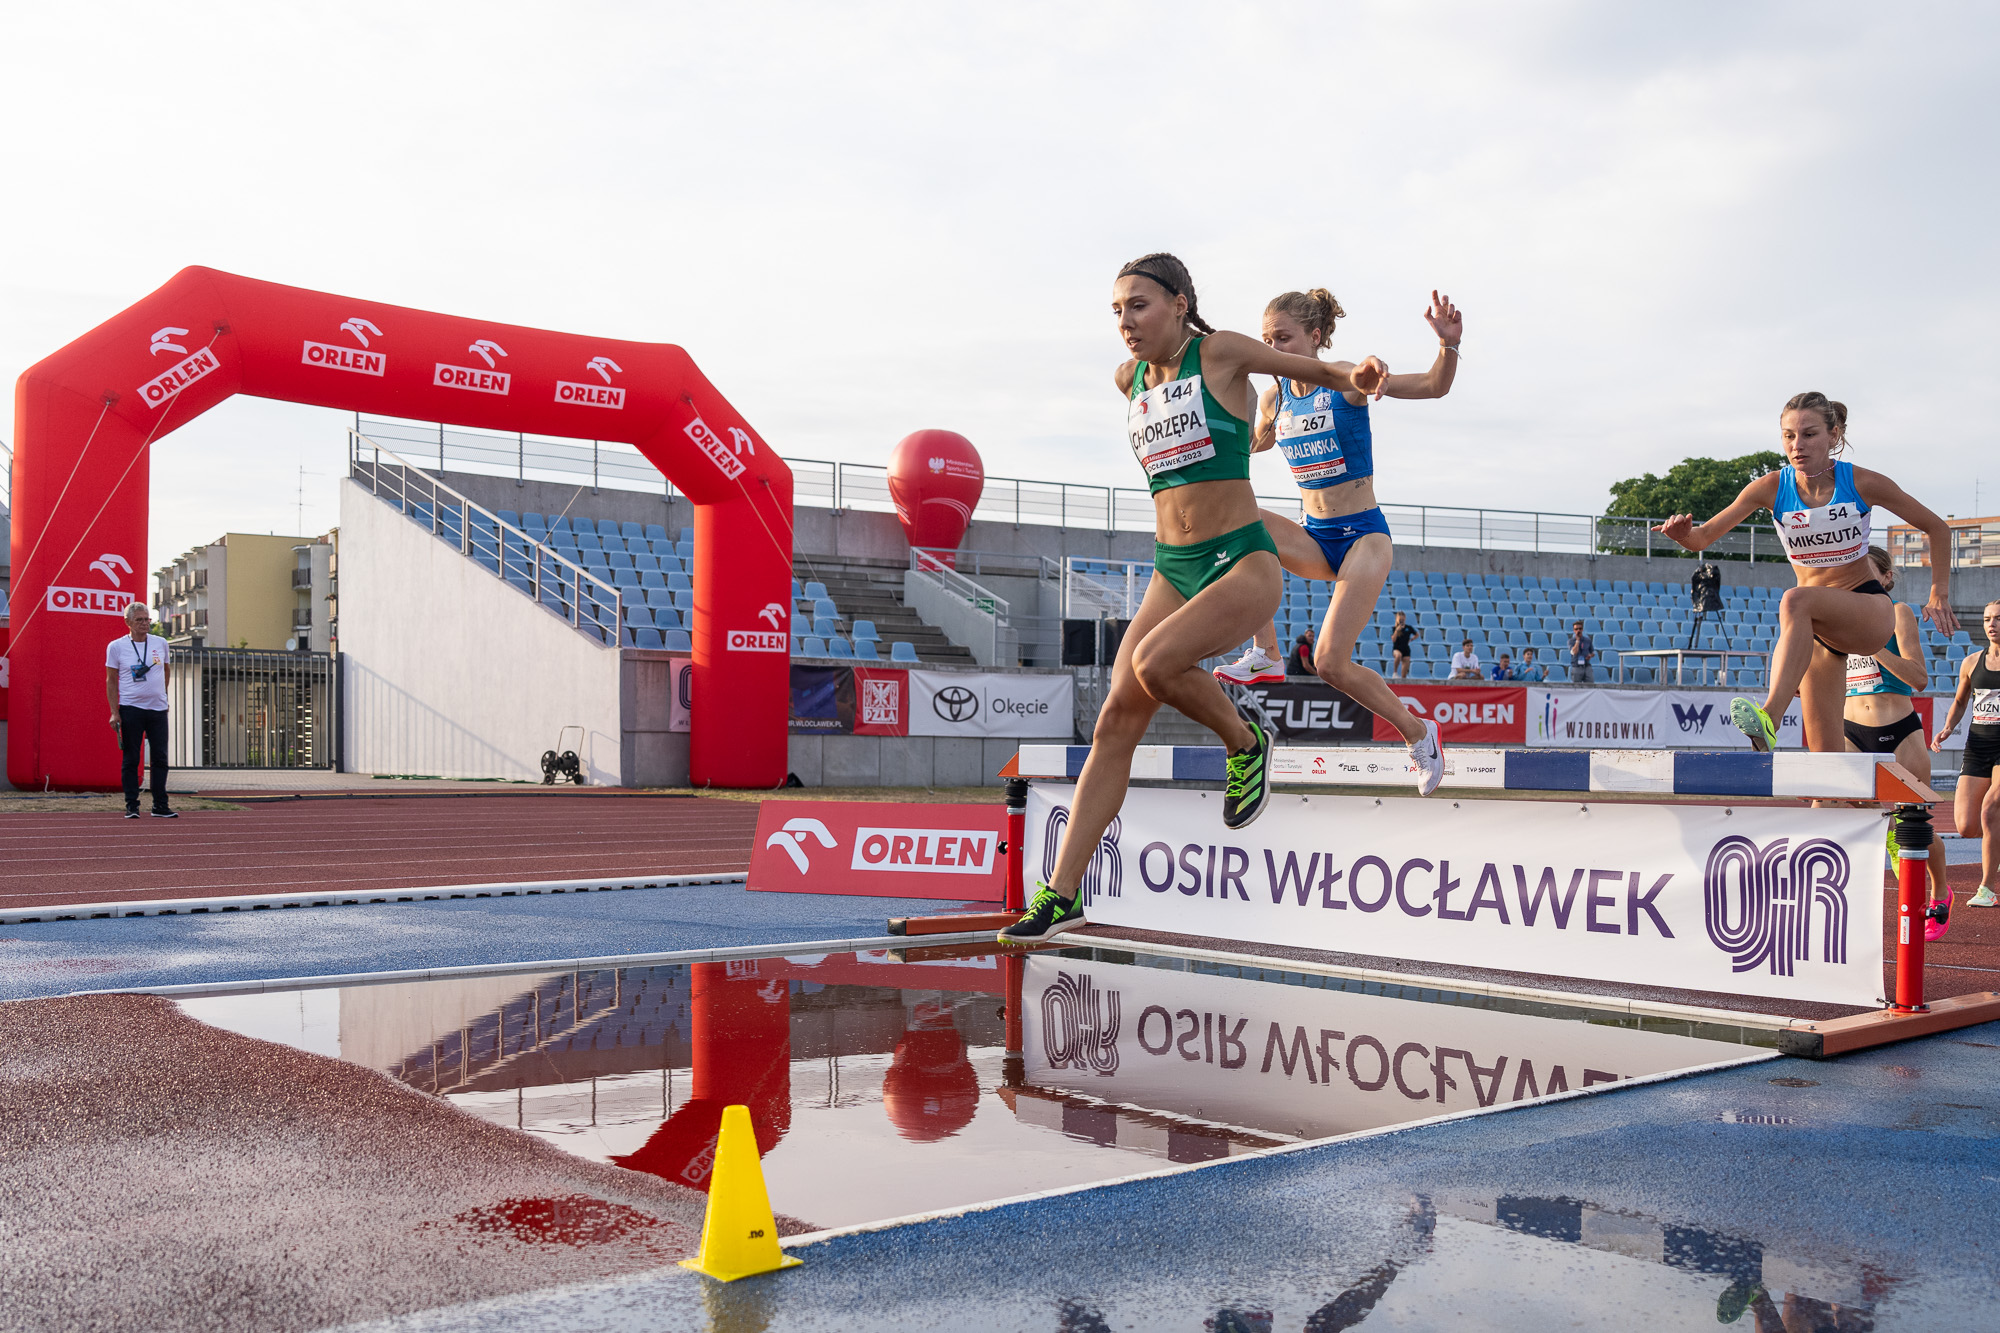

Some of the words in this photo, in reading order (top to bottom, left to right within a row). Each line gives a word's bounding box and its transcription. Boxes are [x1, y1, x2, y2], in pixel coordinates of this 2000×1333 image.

[307, 345, 381, 373] ORLEN
[146, 353, 214, 401] ORLEN
[439, 367, 507, 392] ORLEN
[559, 385, 622, 406] ORLEN
[1162, 382, 1193, 404] 144
[1132, 410, 1202, 450] CHORZĘPA
[1302, 415, 1326, 431] 267
[691, 424, 741, 475] ORLEN
[1183, 450, 1202, 462] 2023
[1829, 506, 1848, 521] 54
[1788, 526, 1862, 548] MIKSZUTA
[1844, 552, 1859, 560] 2023
[52, 590, 130, 612] ORLEN
[731, 633, 786, 650] ORLEN
[992, 698, 1048, 717] Okęcie
[1266, 699, 1354, 729] FUEL
[1434, 702, 1514, 724] ORLEN
[1566, 721, 1655, 740] WZORCOWNIA
[861, 834, 990, 867] ORLEN
[1139, 841, 1251, 901] OSIR
[1263, 848, 1675, 939] WŁOCŁAWEK
